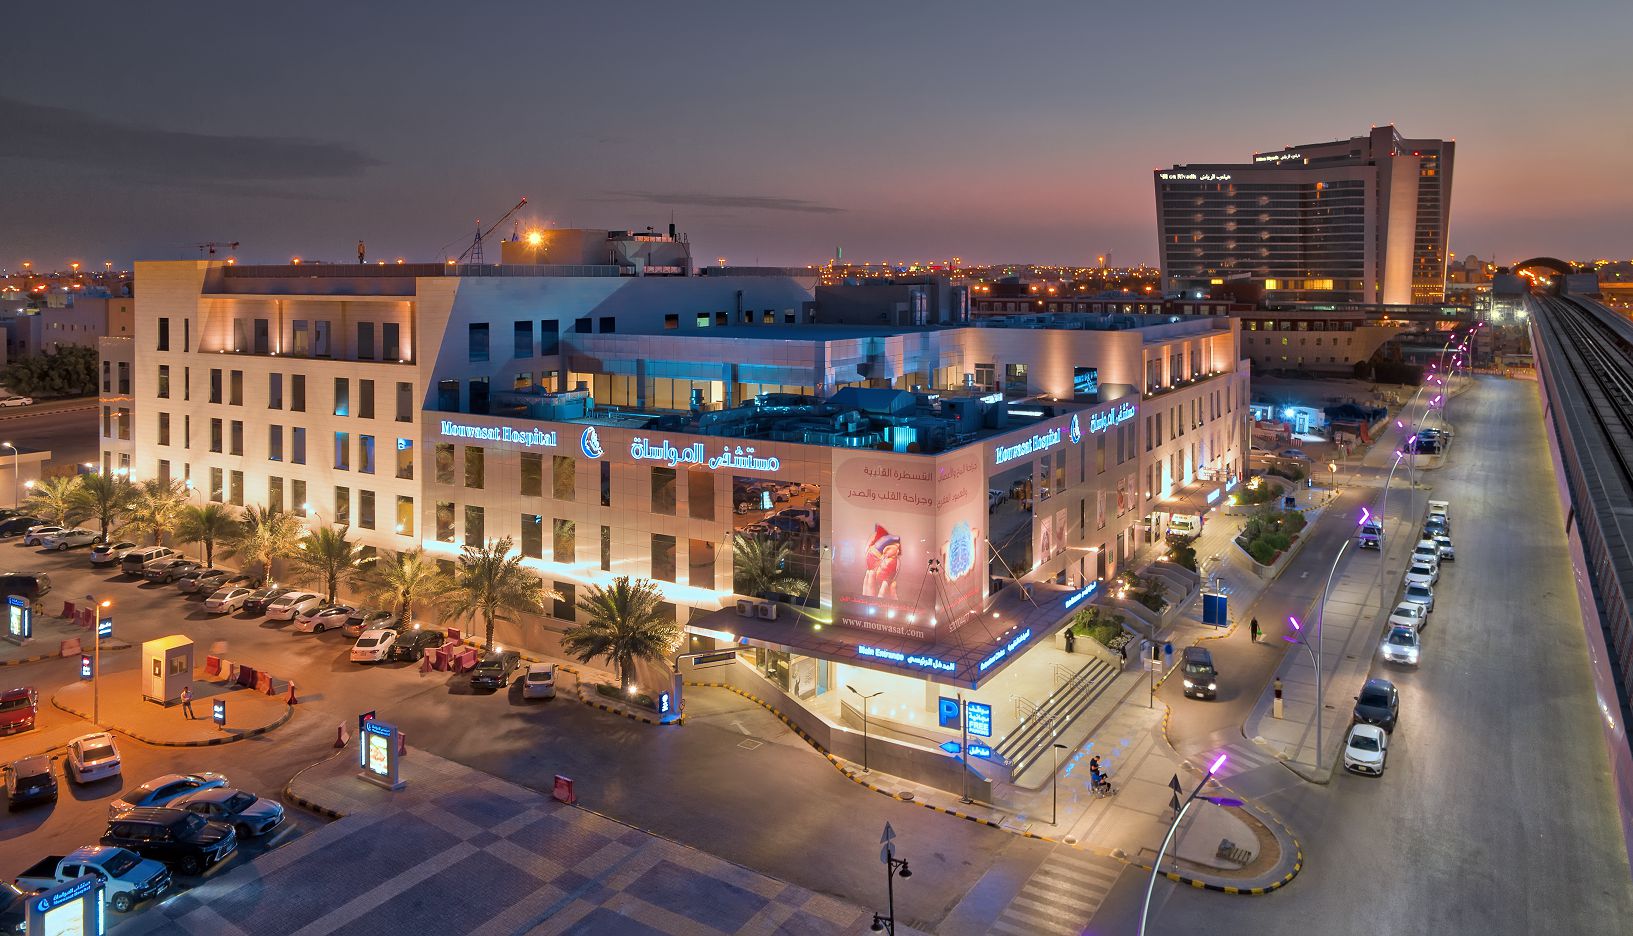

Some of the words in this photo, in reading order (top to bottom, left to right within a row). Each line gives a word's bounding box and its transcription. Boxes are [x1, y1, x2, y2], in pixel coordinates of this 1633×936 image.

[441, 420, 500, 441] Mouwasat
[502, 426, 557, 447] Hospital
[631, 437, 704, 467] المواساة
[995, 439, 1032, 465] Mouwasat
[1032, 427, 1061, 451] Hospital
[709, 446, 780, 472] مستشفى
[863, 466, 892, 477] القلبية
[893, 472, 933, 481] القسطرة
[848, 488, 876, 500] والصدر
[878, 490, 901, 501] القلب
[903, 492, 933, 506] وجراحة
[842, 618, 924, 638] www.mouwasat.com
[859, 645, 875, 656] Main
[875, 648, 905, 661] Entrance
[940, 700, 959, 726] P
[969, 721, 989, 730] FREE
